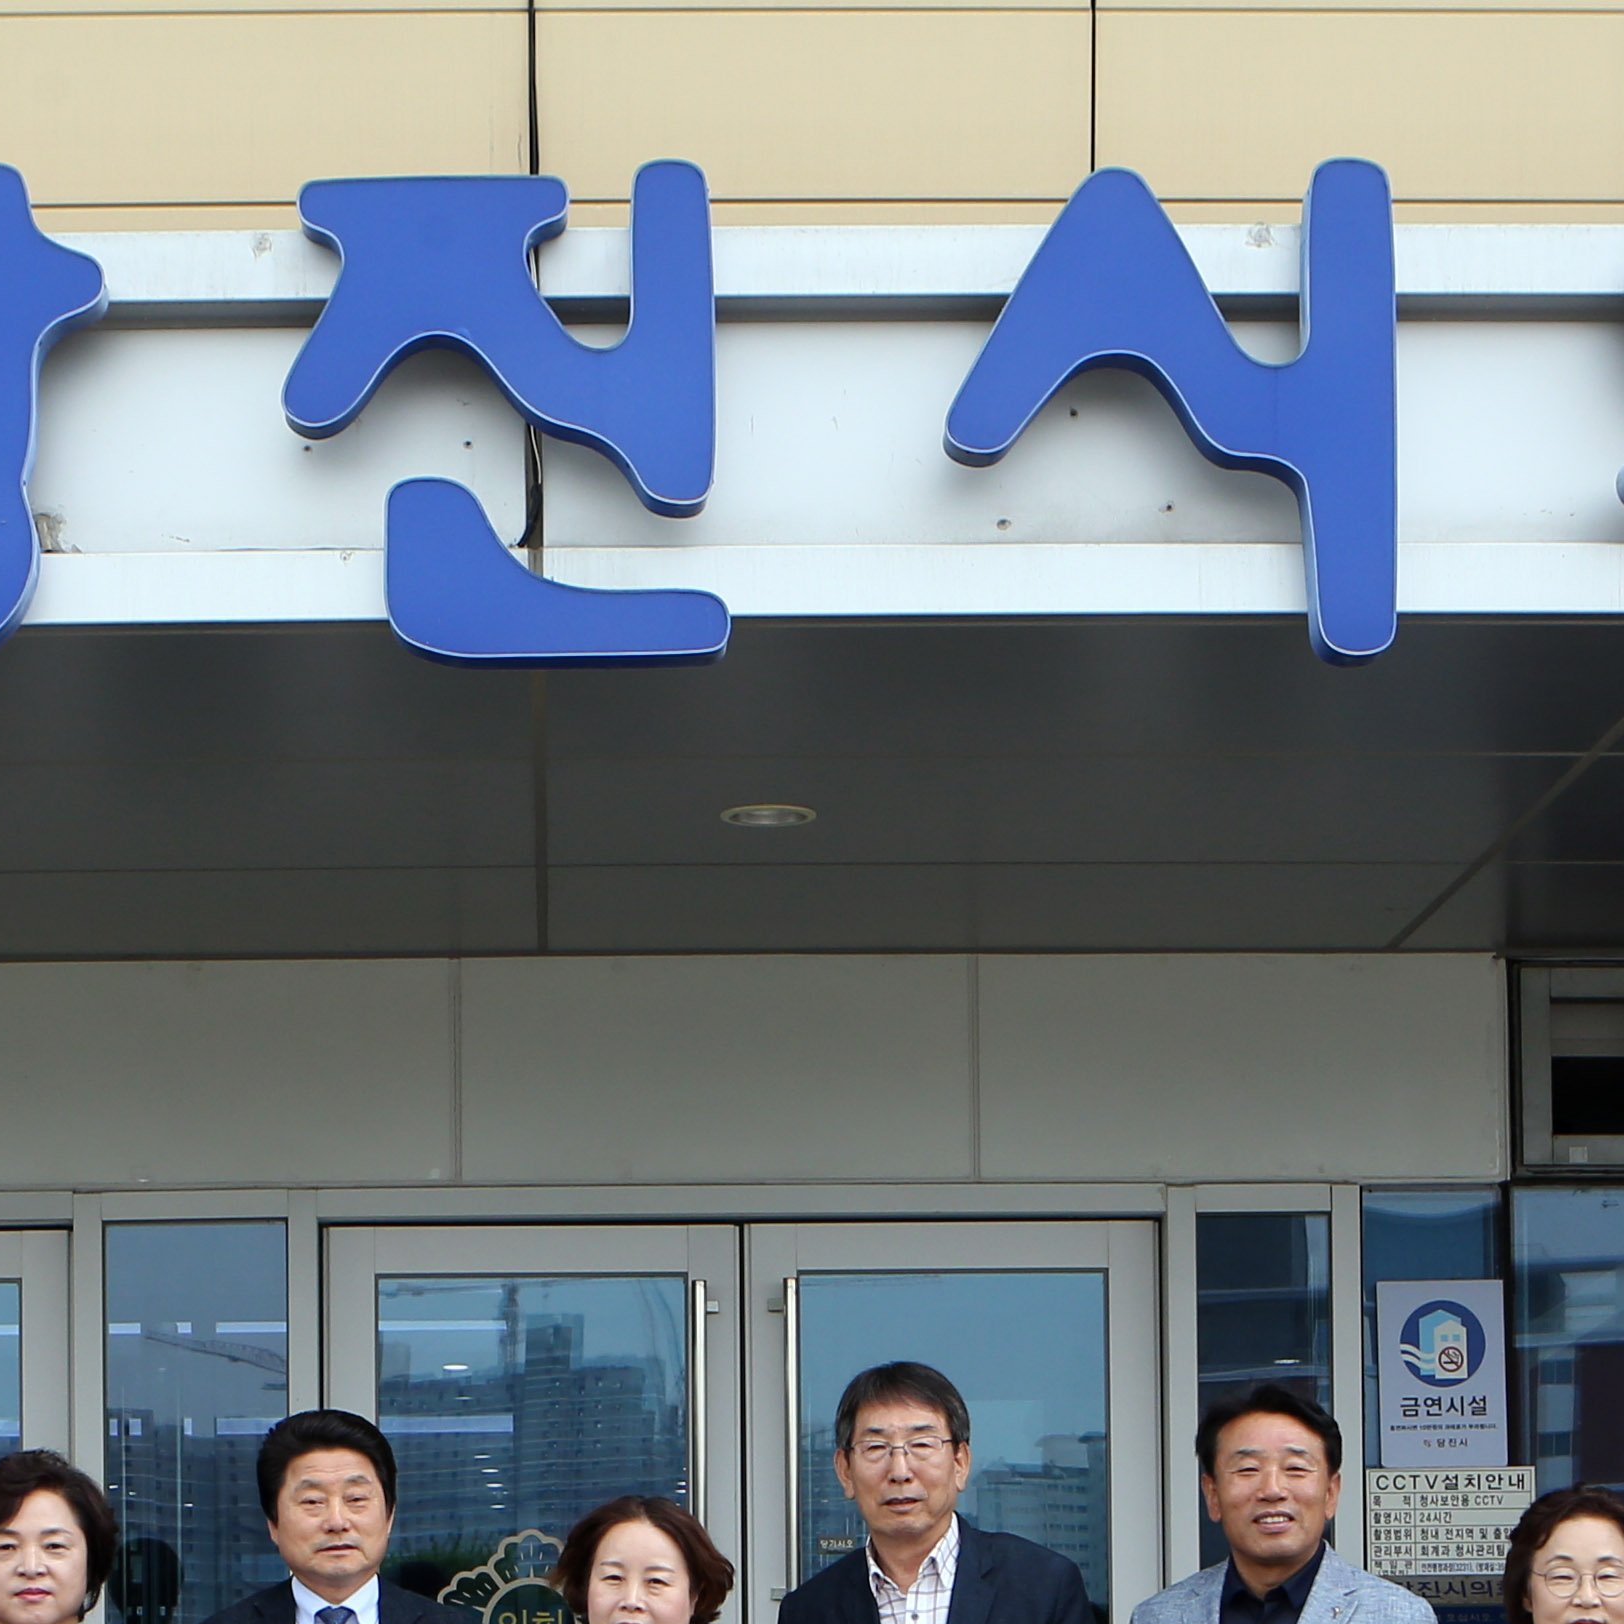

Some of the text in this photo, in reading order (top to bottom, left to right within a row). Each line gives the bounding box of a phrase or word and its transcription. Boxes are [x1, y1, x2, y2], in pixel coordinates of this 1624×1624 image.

[1400, 1395, 1488, 1418] 금연시설
[1436, 1438, 1468, 1448] 당진시
[1375, 1473, 1525, 1491] CCTV설치안내
[1419, 1494, 1470, 1507] 청사보안용
[1474, 1495, 1504, 1506] CCTV
[1373, 1511, 1452, 1524] 촬영시간 24시간
[1373, 1528, 1412, 1541] 촬영범위
[1445, 1528, 1474, 1540] 전지역
[1373, 1545, 1412, 1557] 관리부서
[1420, 1545, 1450, 1557] 회계과
